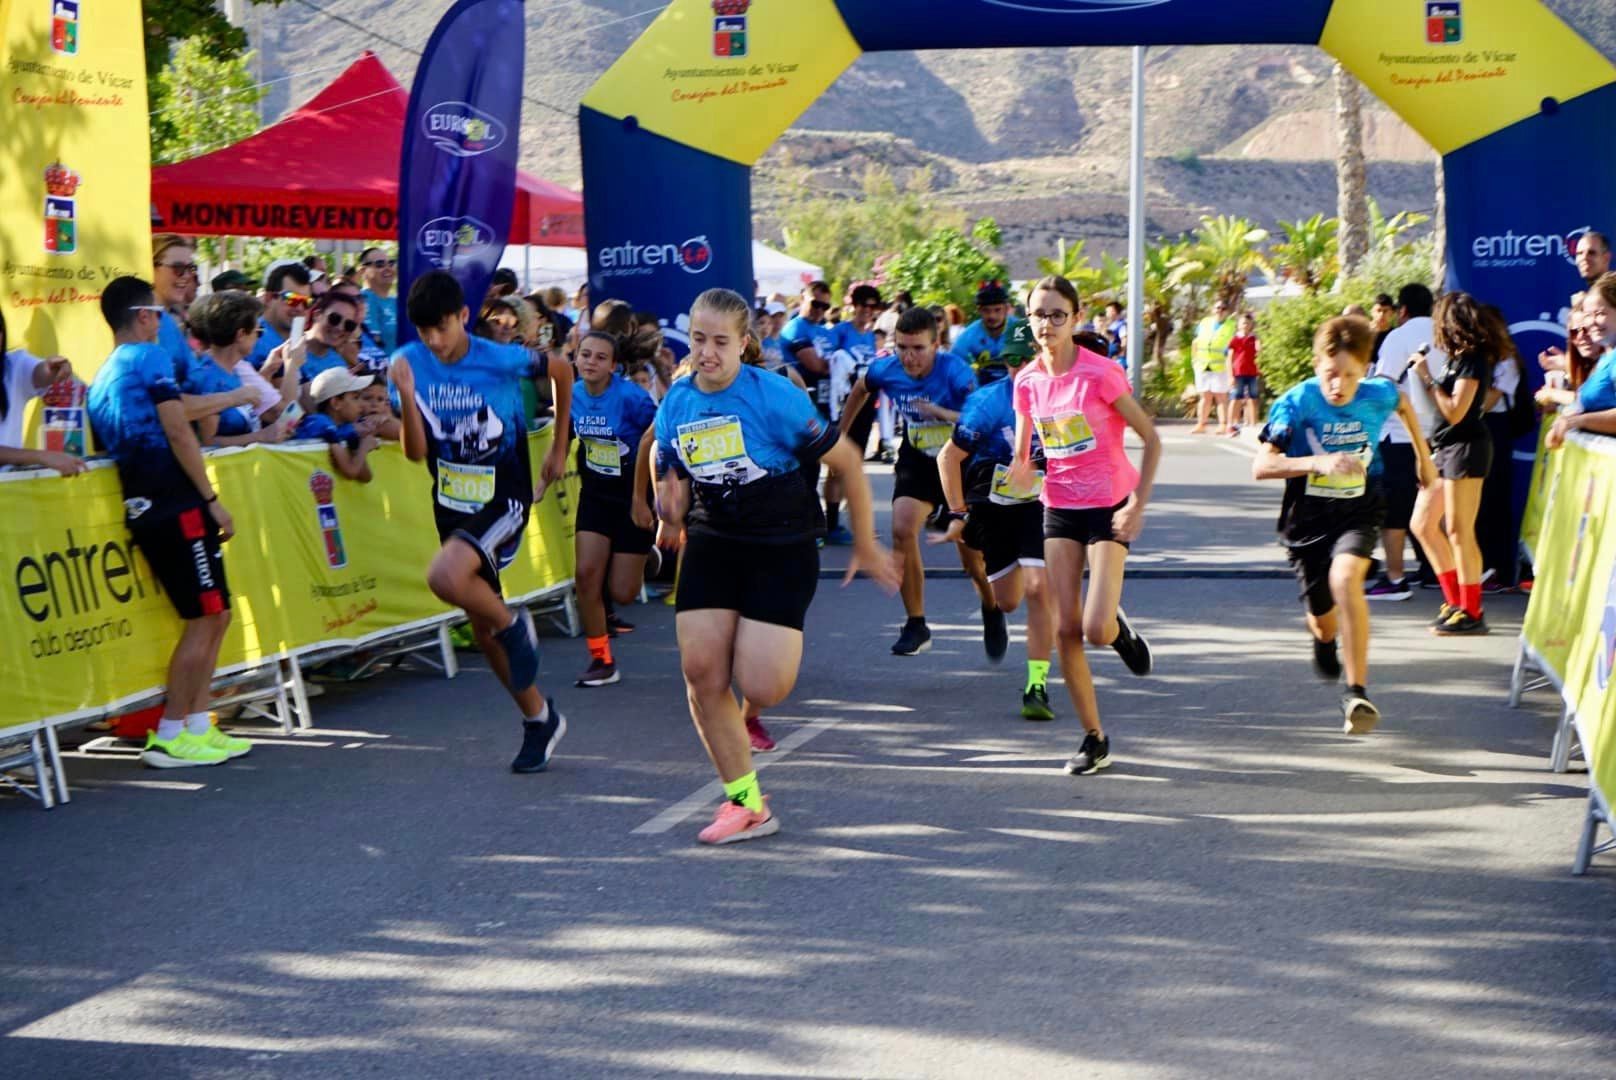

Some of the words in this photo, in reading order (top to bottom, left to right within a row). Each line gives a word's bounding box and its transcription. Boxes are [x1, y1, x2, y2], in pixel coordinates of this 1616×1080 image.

[748, 64, 763, 76] de
[1463, 51, 1478, 63] de
[170, 202, 398, 232] MONTUREVENTO
[702, 430, 740, 459] 597
[31, 630, 63, 659] club
[64, 616, 133, 655] deportivo
